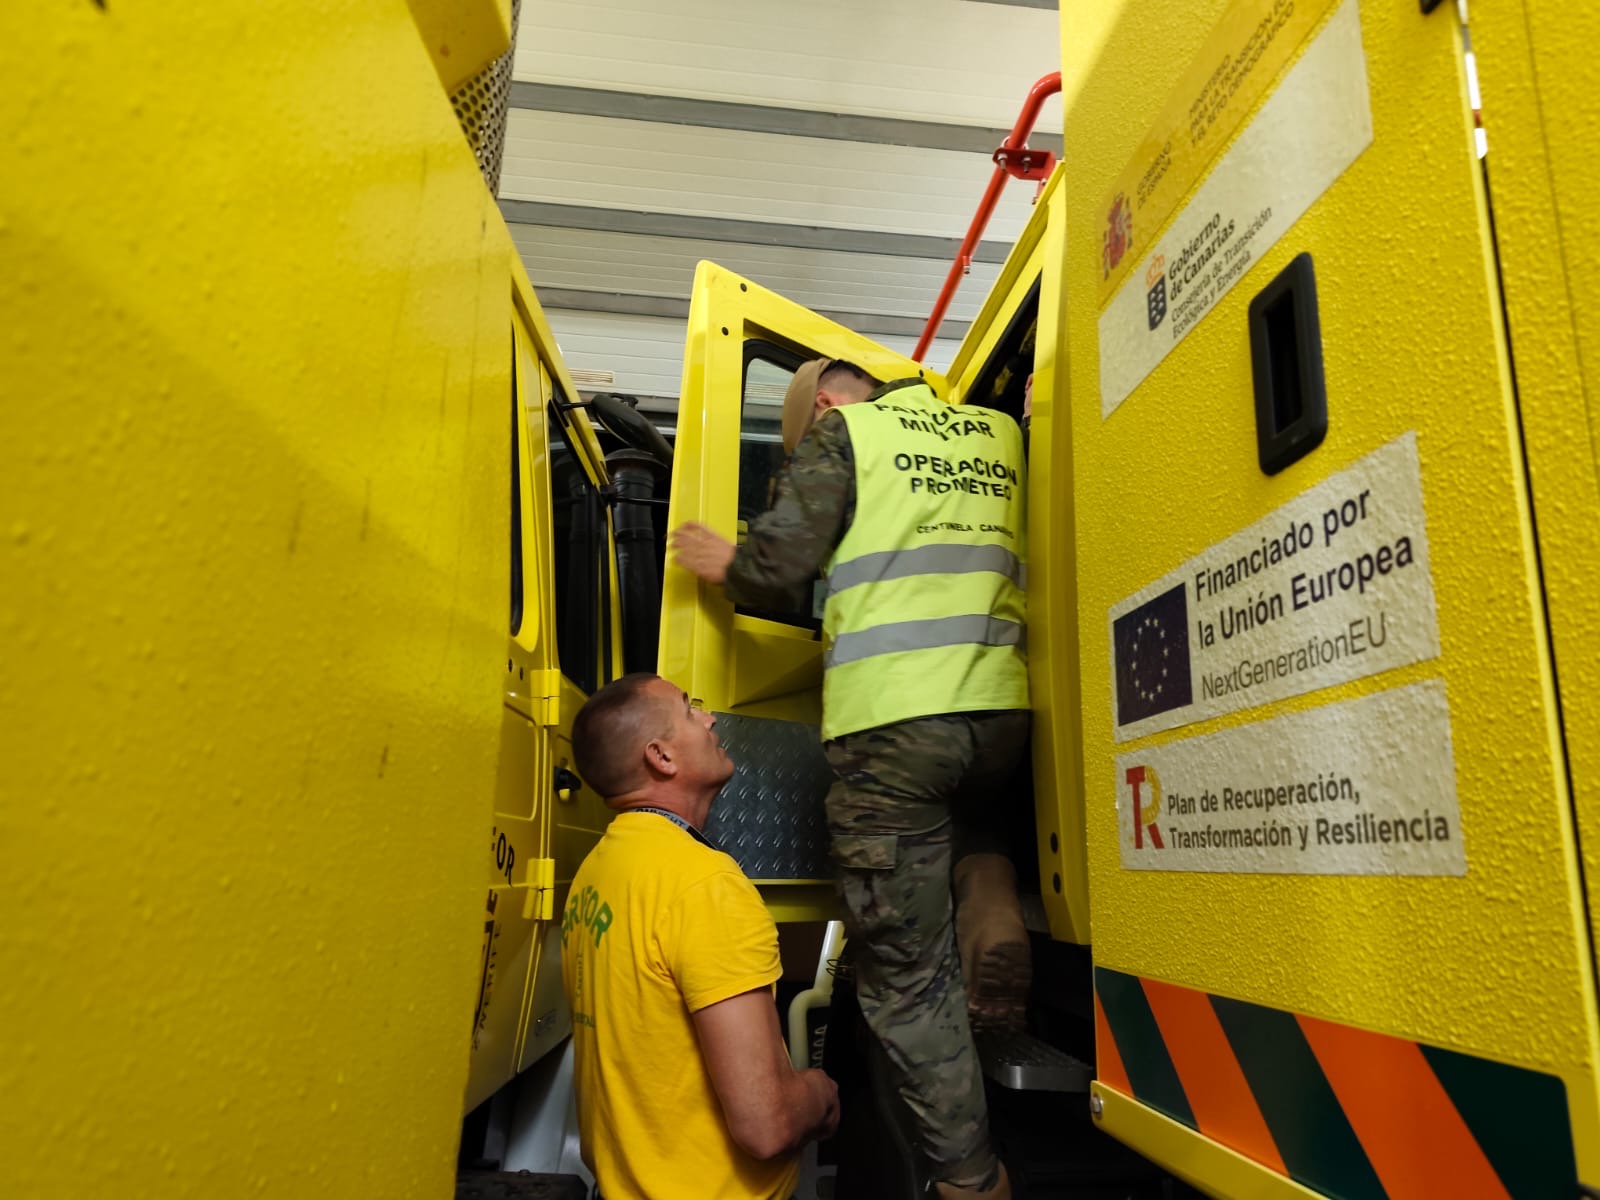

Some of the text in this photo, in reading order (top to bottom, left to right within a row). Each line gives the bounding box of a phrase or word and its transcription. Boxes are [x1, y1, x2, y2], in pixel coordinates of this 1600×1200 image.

[1168, 212, 1221, 280] Gobierno
[1169, 218, 1235, 301] de Canarias
[1212, 260, 1222, 279] de
[1223, 206, 1272, 265] Transición
[894, 453, 1018, 486] OPERACIÓN
[911, 477, 1012, 501] PROMETEO
[1195, 489, 1371, 602] Financiado por
[1198, 536, 1414, 649] la Unión Europea
[1202, 612, 1388, 701] NextGenerationEU
[1167, 771, 1361, 817] Plan de Recuperación,
[1169, 809, 1450, 851] Transformación y Resiliencia
